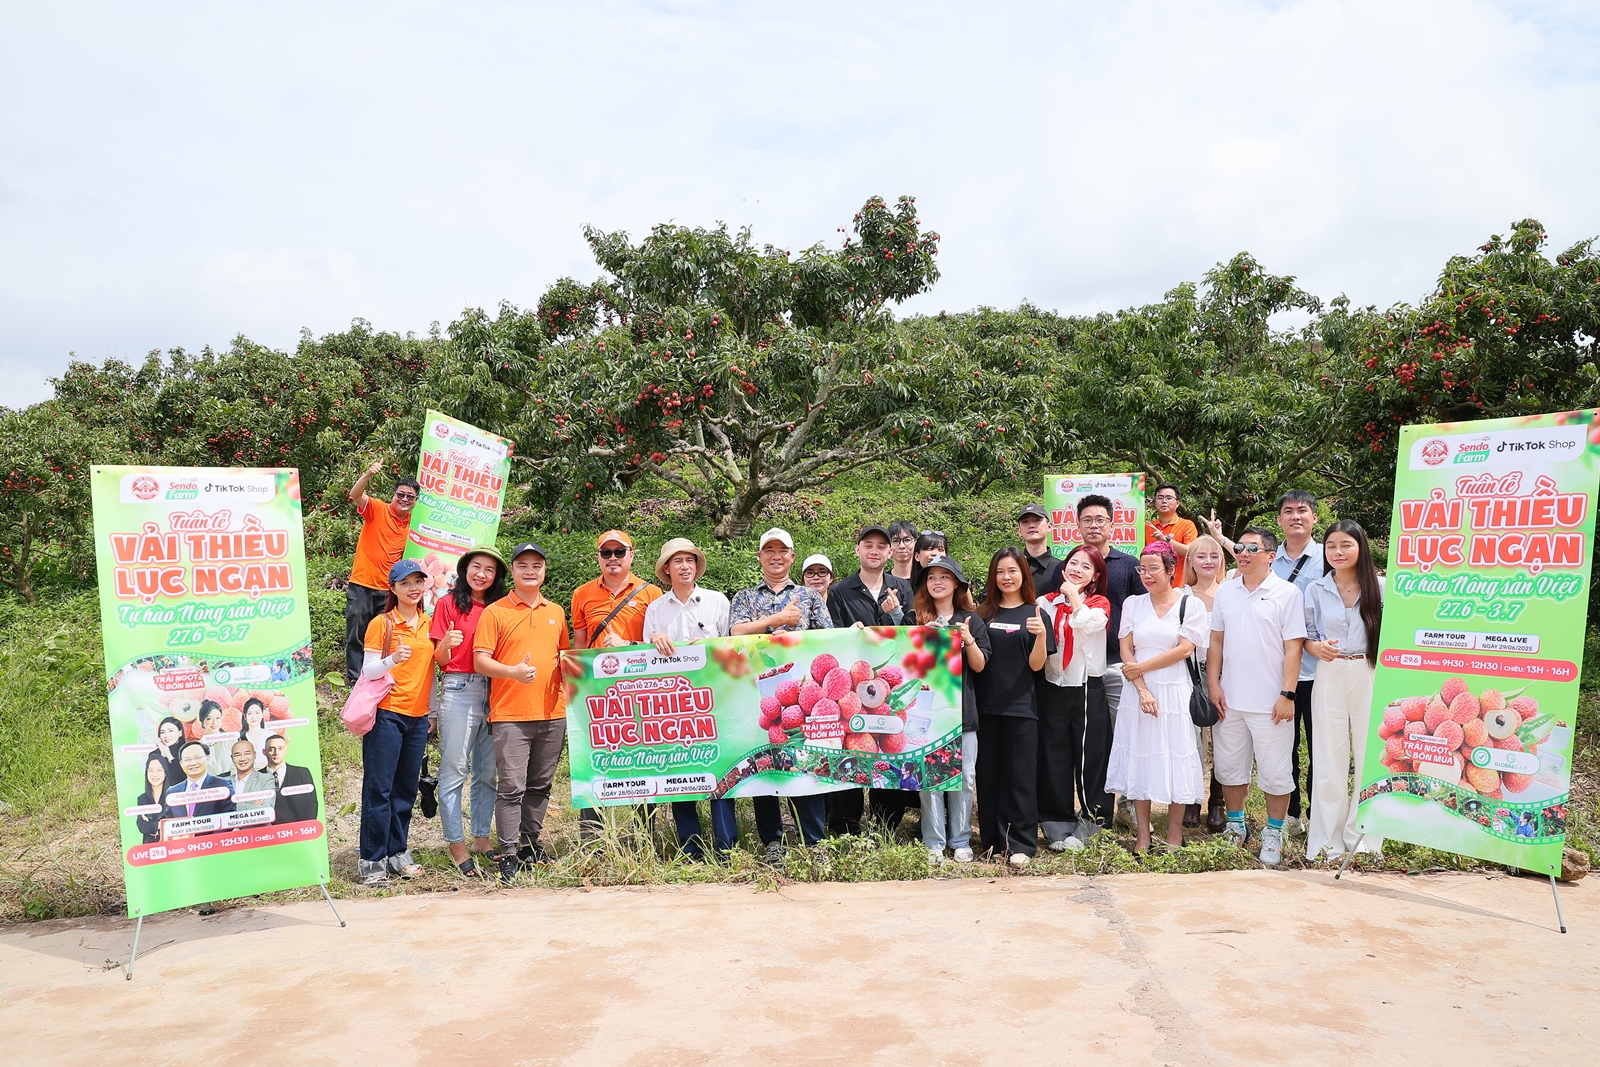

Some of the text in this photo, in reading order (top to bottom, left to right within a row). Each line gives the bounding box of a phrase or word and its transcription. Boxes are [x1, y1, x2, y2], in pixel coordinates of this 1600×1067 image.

[476, 442, 490, 450] TikTok
[1458, 442, 1489, 452] Sendo
[1509, 440, 1576, 451] TikTok Shop
[1458, 453, 1486, 462] Farm
[423, 452, 502, 492] VẢI THIỀU
[169, 482, 197, 490] Sendo
[247, 484, 268, 494] Shop
[420, 470, 499, 509] LỤC NGẠN
[1459, 473, 1520, 494] Tuần lễ
[169, 491, 195, 499] Farm
[1402, 479, 1584, 528] VẢI THIỀU
[173, 512, 228, 528] Tuần lễ
[430, 512, 447, 522] 27.6
[455, 519, 470, 529] 3.7
[1052, 505, 1079, 524] VẢ
[112, 516, 284, 561] VẢI THIỀU
[1053, 528, 1083, 545] LỤC
[1400, 534, 1580, 571] LỤC NGẠN
[116, 565, 290, 603] LỤC NGẠN
[1397, 573, 1580, 599] Tự hào Nông sản Việt
[120, 599, 293, 625] Tự hào Nông sản Việt
[1439, 602, 1471, 616] 27.6
[1489, 603, 1520, 619] 3.7
[169, 629, 202, 644] 27.6
[219, 626, 248, 640] 3.7
[658, 656, 681, 664] TikTok
[1404, 656, 1419, 664] 29.6
[1423, 658, 1440, 666] SÁNG:
[1442, 660, 1464, 668] 9H30
[1471, 661, 1498, 670] 12H30
[1526, 665, 1544, 674] 13H
[1552, 667, 1570, 676] 16H
[156, 674, 198, 683] TRÁI NGỌT
[619, 681, 635, 690] Tuần
[588, 679, 712, 720] VẢI THIỀU
[591, 718, 715, 750] LỤC NGẠN
[802, 723, 818, 731] TRÁI
[1404, 741, 1449, 754] TRÁI NGỌT
[594, 746, 716, 768] Tự hào Nông sản Việt
[1413, 751, 1453, 764] BỐN MÙA
[172, 820, 190, 828] FARM
[229, 812, 248, 820] MEGA
[243, 816, 270, 825] 29/06/2025
[189, 825, 214, 833] 28/06/2025
[133, 852, 149, 860] LIVE
[188, 842, 213, 852] 9H30
[220, 836, 249, 846] 12H30
[276, 830, 293, 838] 13H
[300, 826, 316, 834] 16H
